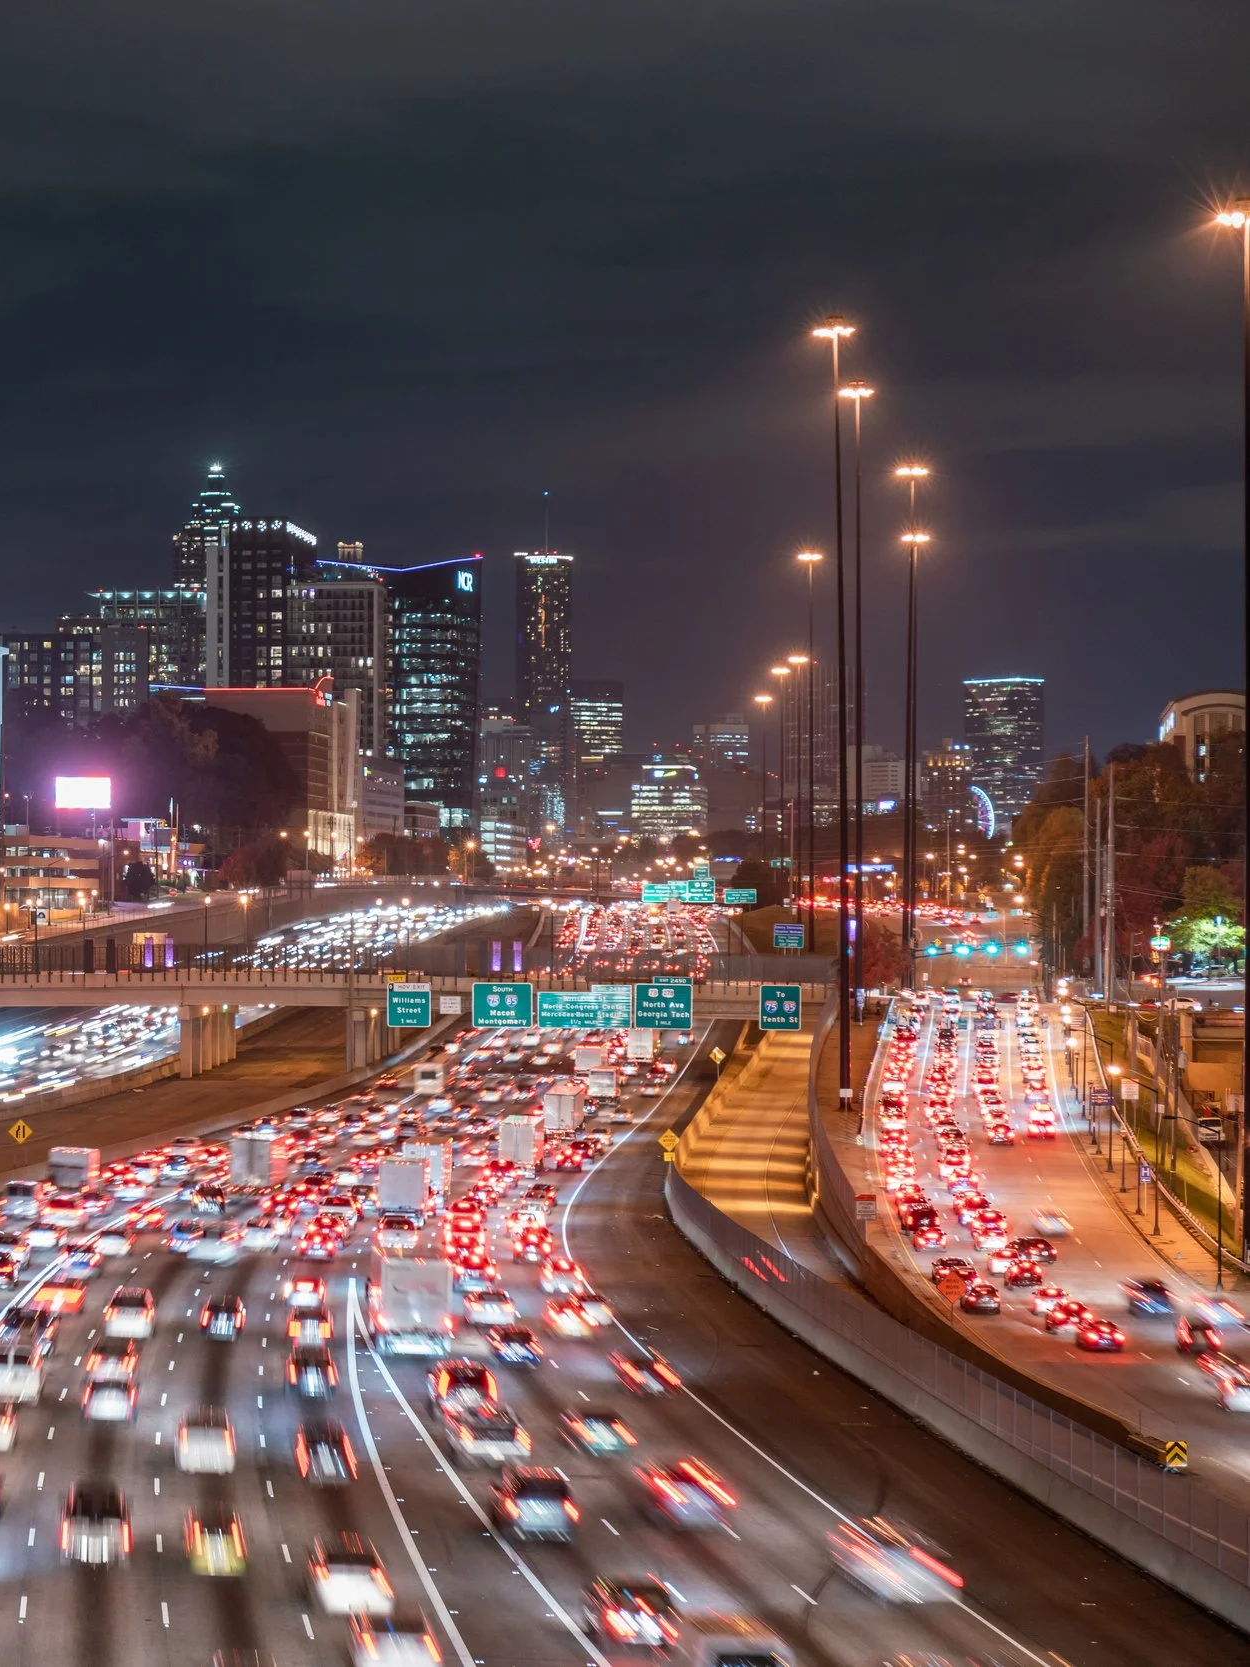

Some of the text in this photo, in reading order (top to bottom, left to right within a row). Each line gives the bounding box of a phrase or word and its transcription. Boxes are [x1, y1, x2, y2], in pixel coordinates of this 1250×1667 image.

[458, 570, 473, 592] NCR
[565, 1003, 599, 1011] Congress
[490, 1009, 516, 1017] Macon
[637, 1010, 668, 1019] Georgia
[478, 1018, 527, 1026] Montgomery
[1141, 1167, 1150, 1177] H
